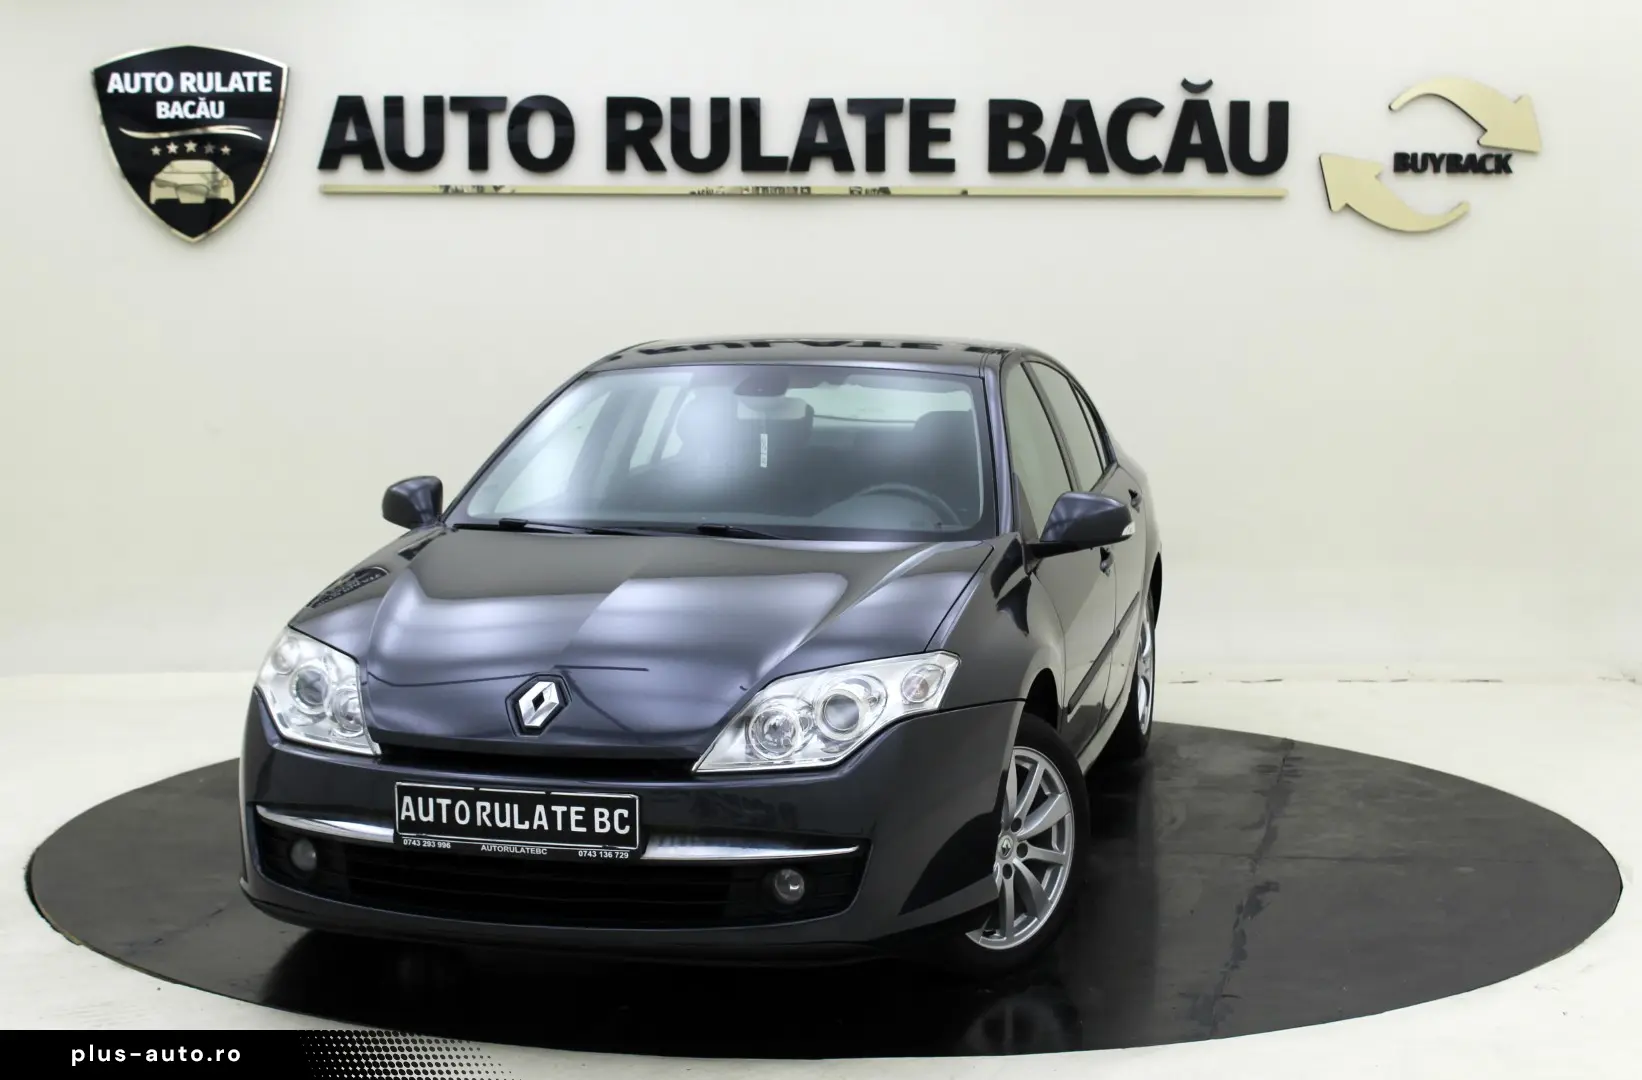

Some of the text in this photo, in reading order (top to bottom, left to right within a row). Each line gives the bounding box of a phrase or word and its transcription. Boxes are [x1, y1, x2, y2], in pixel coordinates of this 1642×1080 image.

[107, 71, 273, 94] AUTO RULATE
[156, 97, 225, 119] BACĂU
[318, 78, 1290, 177] AUTO RULATE BACĂU
[1393, 151, 1513, 175] BUYBACK
[593, 807, 631, 835] BC
[403, 839, 452, 850] 0743 293 996
[480, 844, 549, 856] AUTORULATEBC
[578, 850, 630, 860] 0743 136 729
